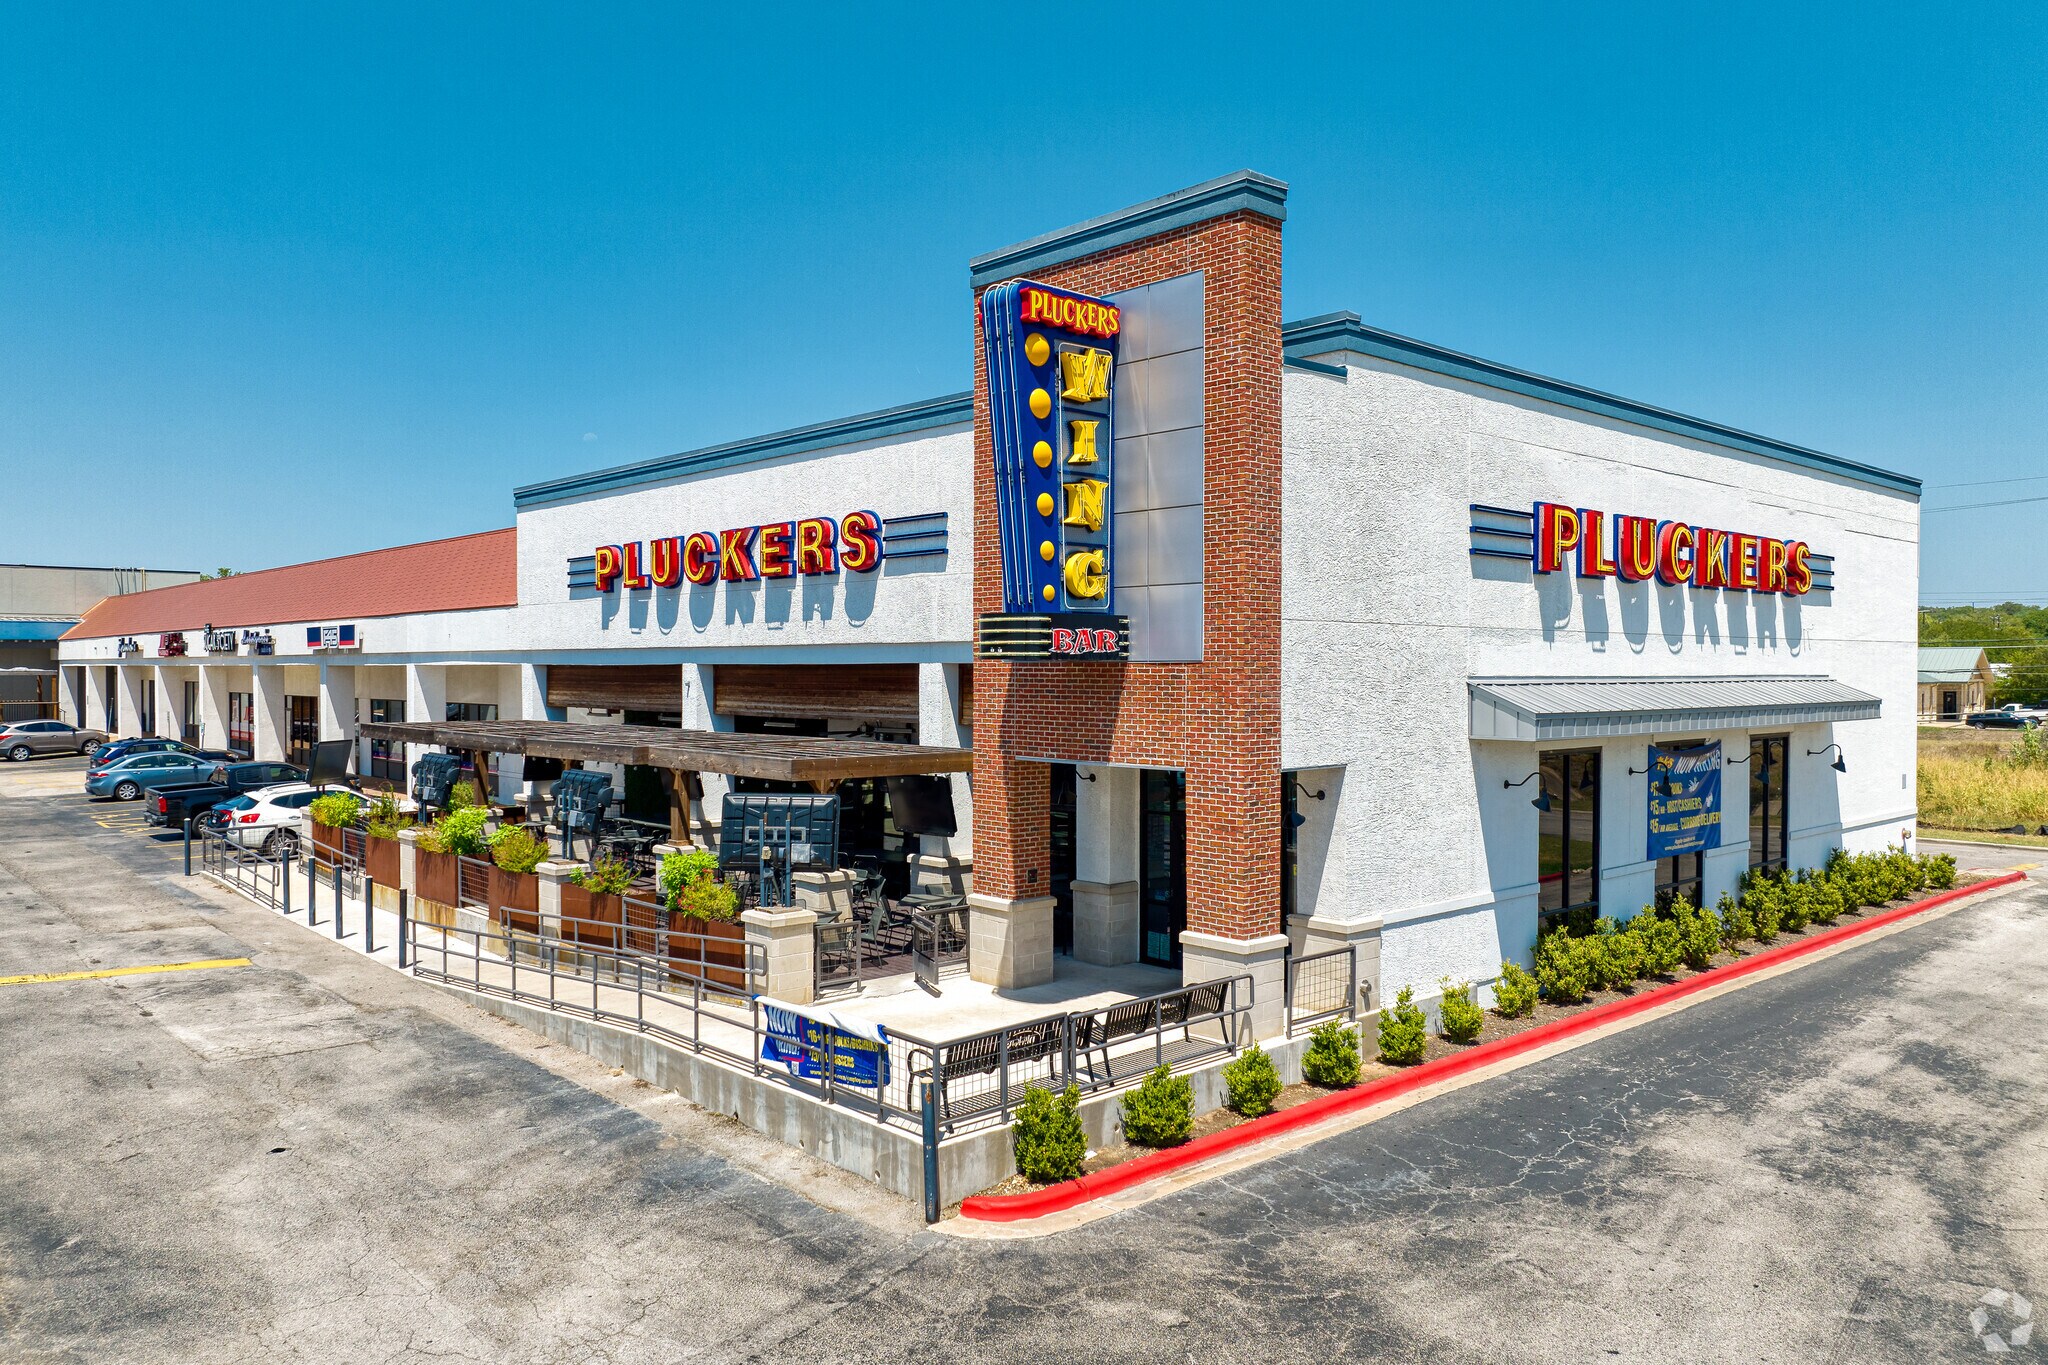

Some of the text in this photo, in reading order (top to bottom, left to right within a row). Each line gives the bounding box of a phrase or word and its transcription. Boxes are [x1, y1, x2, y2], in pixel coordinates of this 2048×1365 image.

[1024, 288, 1120, 337] PLUCKERS
[1061, 346, 1113, 600] WING
[595, 510, 883, 592] PLUCKERS
[1533, 501, 1813, 597] PLUCKERS
[1049, 627, 1120, 655] BAR
[1674, 756, 1697, 774] NOW
[1694, 750, 1721, 773] HIRING
[768, 1005, 797, 1034] NOW
